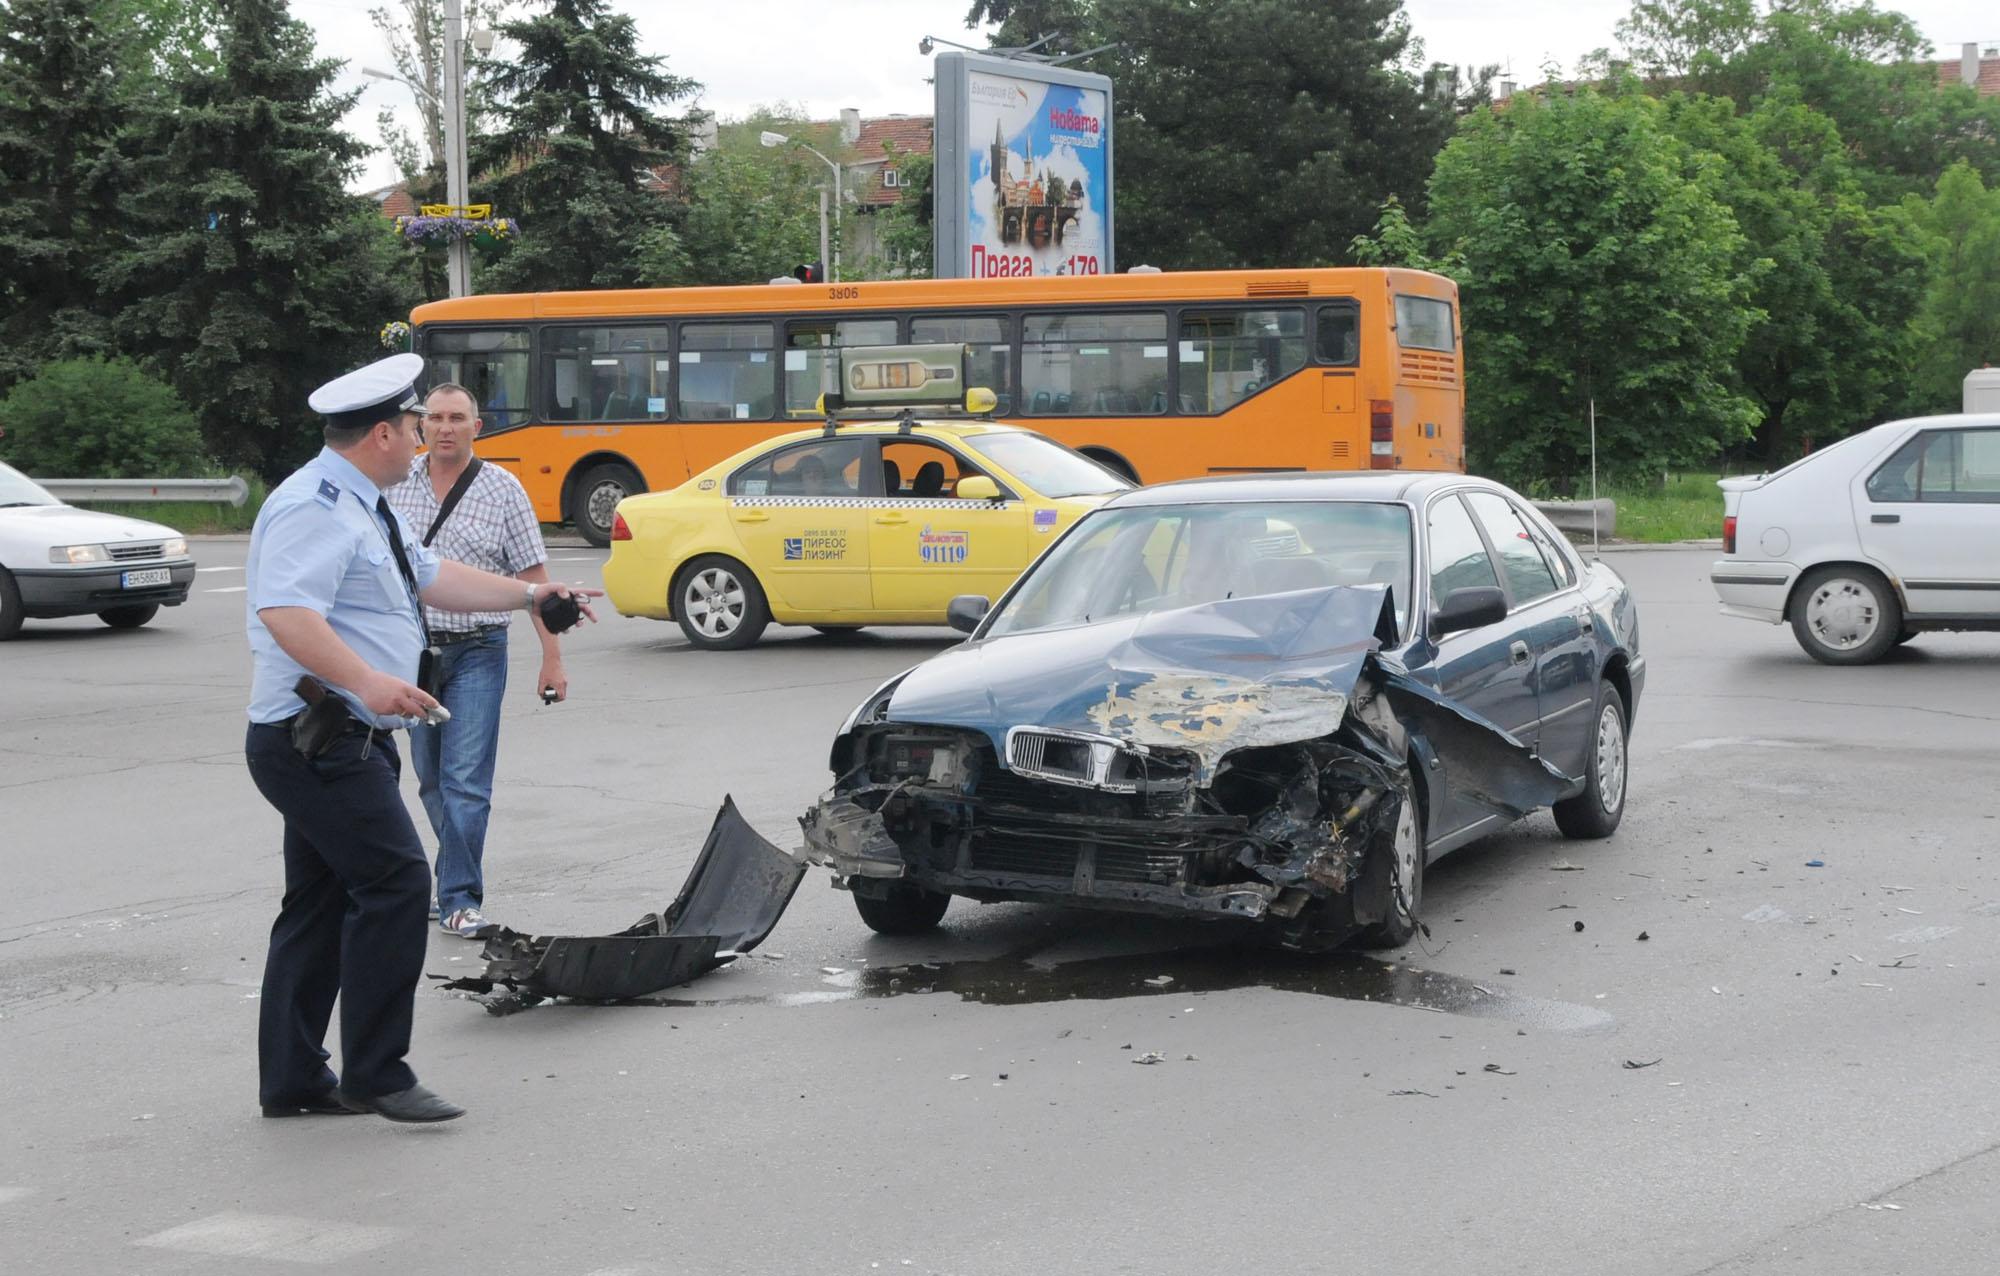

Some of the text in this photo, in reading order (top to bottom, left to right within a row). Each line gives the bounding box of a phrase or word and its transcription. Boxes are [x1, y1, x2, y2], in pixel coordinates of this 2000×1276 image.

[1050, 106, 1098, 134] Новата
[972, 245, 1032, 278] Прага
[829, 287, 858, 299] 3806
[804, 538, 847, 548] ПИРЕОС
[804, 550, 847, 560] ЛИЗИНГ
[922, 545, 965, 563] 91119
